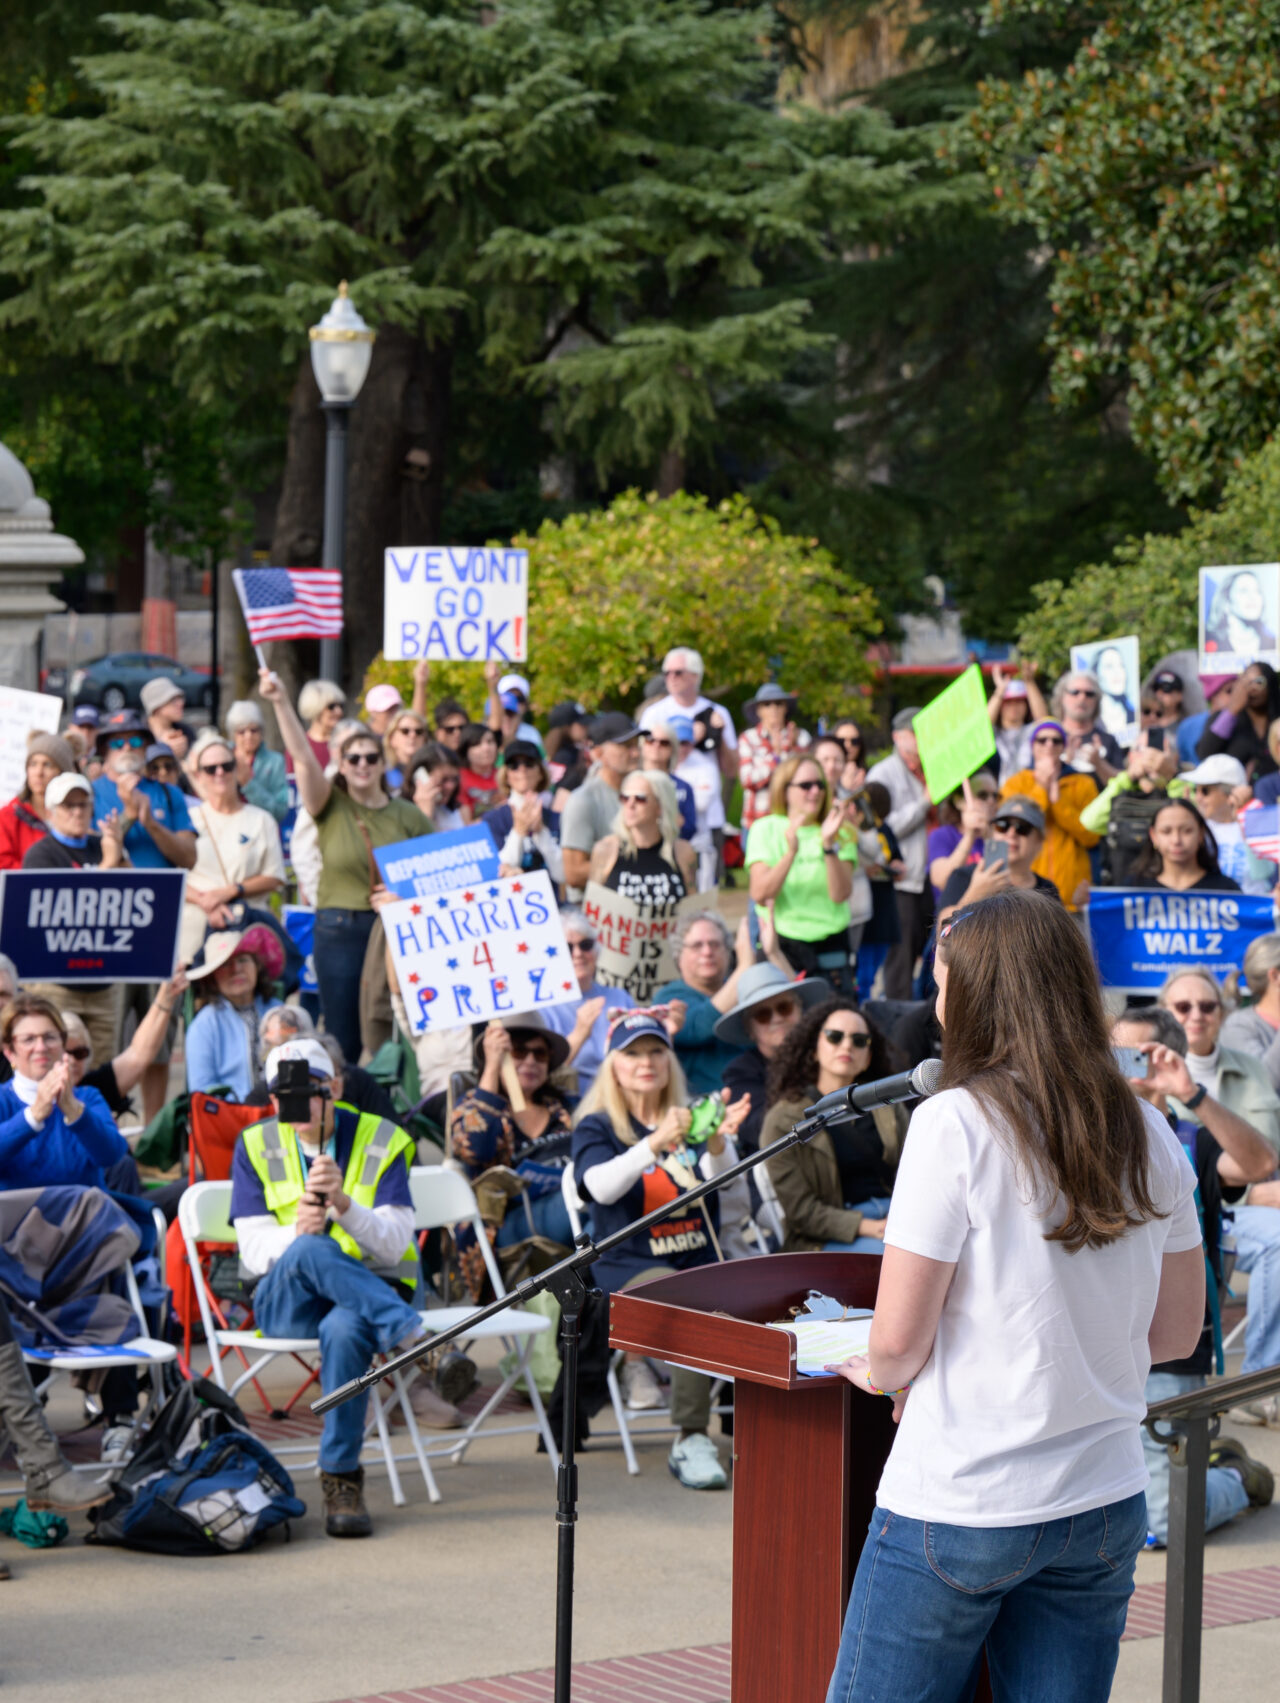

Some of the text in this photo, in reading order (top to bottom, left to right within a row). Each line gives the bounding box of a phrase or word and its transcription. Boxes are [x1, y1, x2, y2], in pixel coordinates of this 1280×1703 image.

[390, 547, 528, 584] WE WONT
[435, 586, 484, 618] GO
[401, 616, 524, 662] BACK!
[27, 887, 156, 929] HARRIS
[394, 890, 550, 958] HARRIS
[1122, 896, 1240, 932] HARRIS
[45, 928, 135, 953] WALZ
[472, 940, 495, 973] 4
[640, 940, 663, 959] IS
[1143, 931, 1224, 956] WALZ
[67, 957, 105, 970] 2024
[630, 962, 658, 979] AN
[416, 966, 555, 1022] PREZ
[648, 1230, 708, 1257] MARCH
